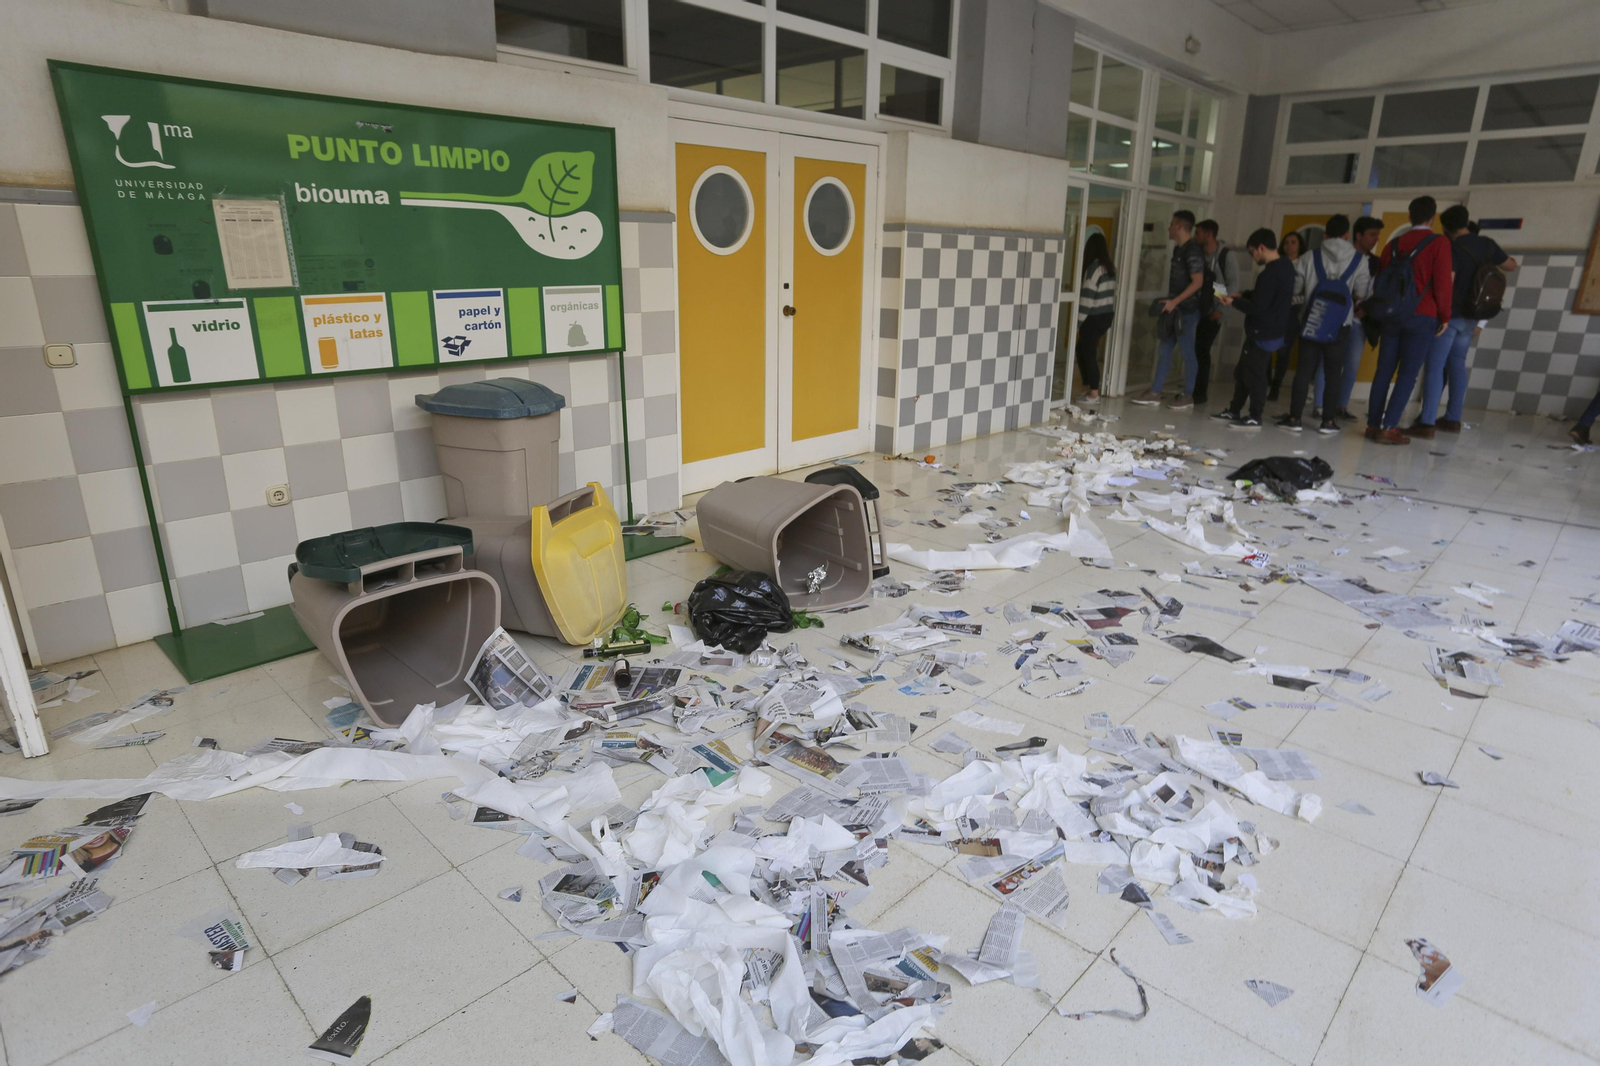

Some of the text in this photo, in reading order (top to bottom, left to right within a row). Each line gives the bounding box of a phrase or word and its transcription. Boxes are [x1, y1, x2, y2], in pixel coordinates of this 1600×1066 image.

[287, 134, 511, 172] PUNTO LIMPIO
[115, 179, 204, 190] UNIVERSIDAD
[117, 190, 206, 201] DE MÁLAGA
[294, 182, 390, 205] biouma
[458, 305, 501, 318] papel y
[550, 301, 599, 313] orgánicas
[313, 313, 382, 327] plástico y
[1302, 298, 1329, 338] PUMA
[192, 319, 241, 332] vidrio
[464, 320, 502, 331] cartón
[349, 328, 383, 339] latas
[203, 922, 238, 951] MASTER
